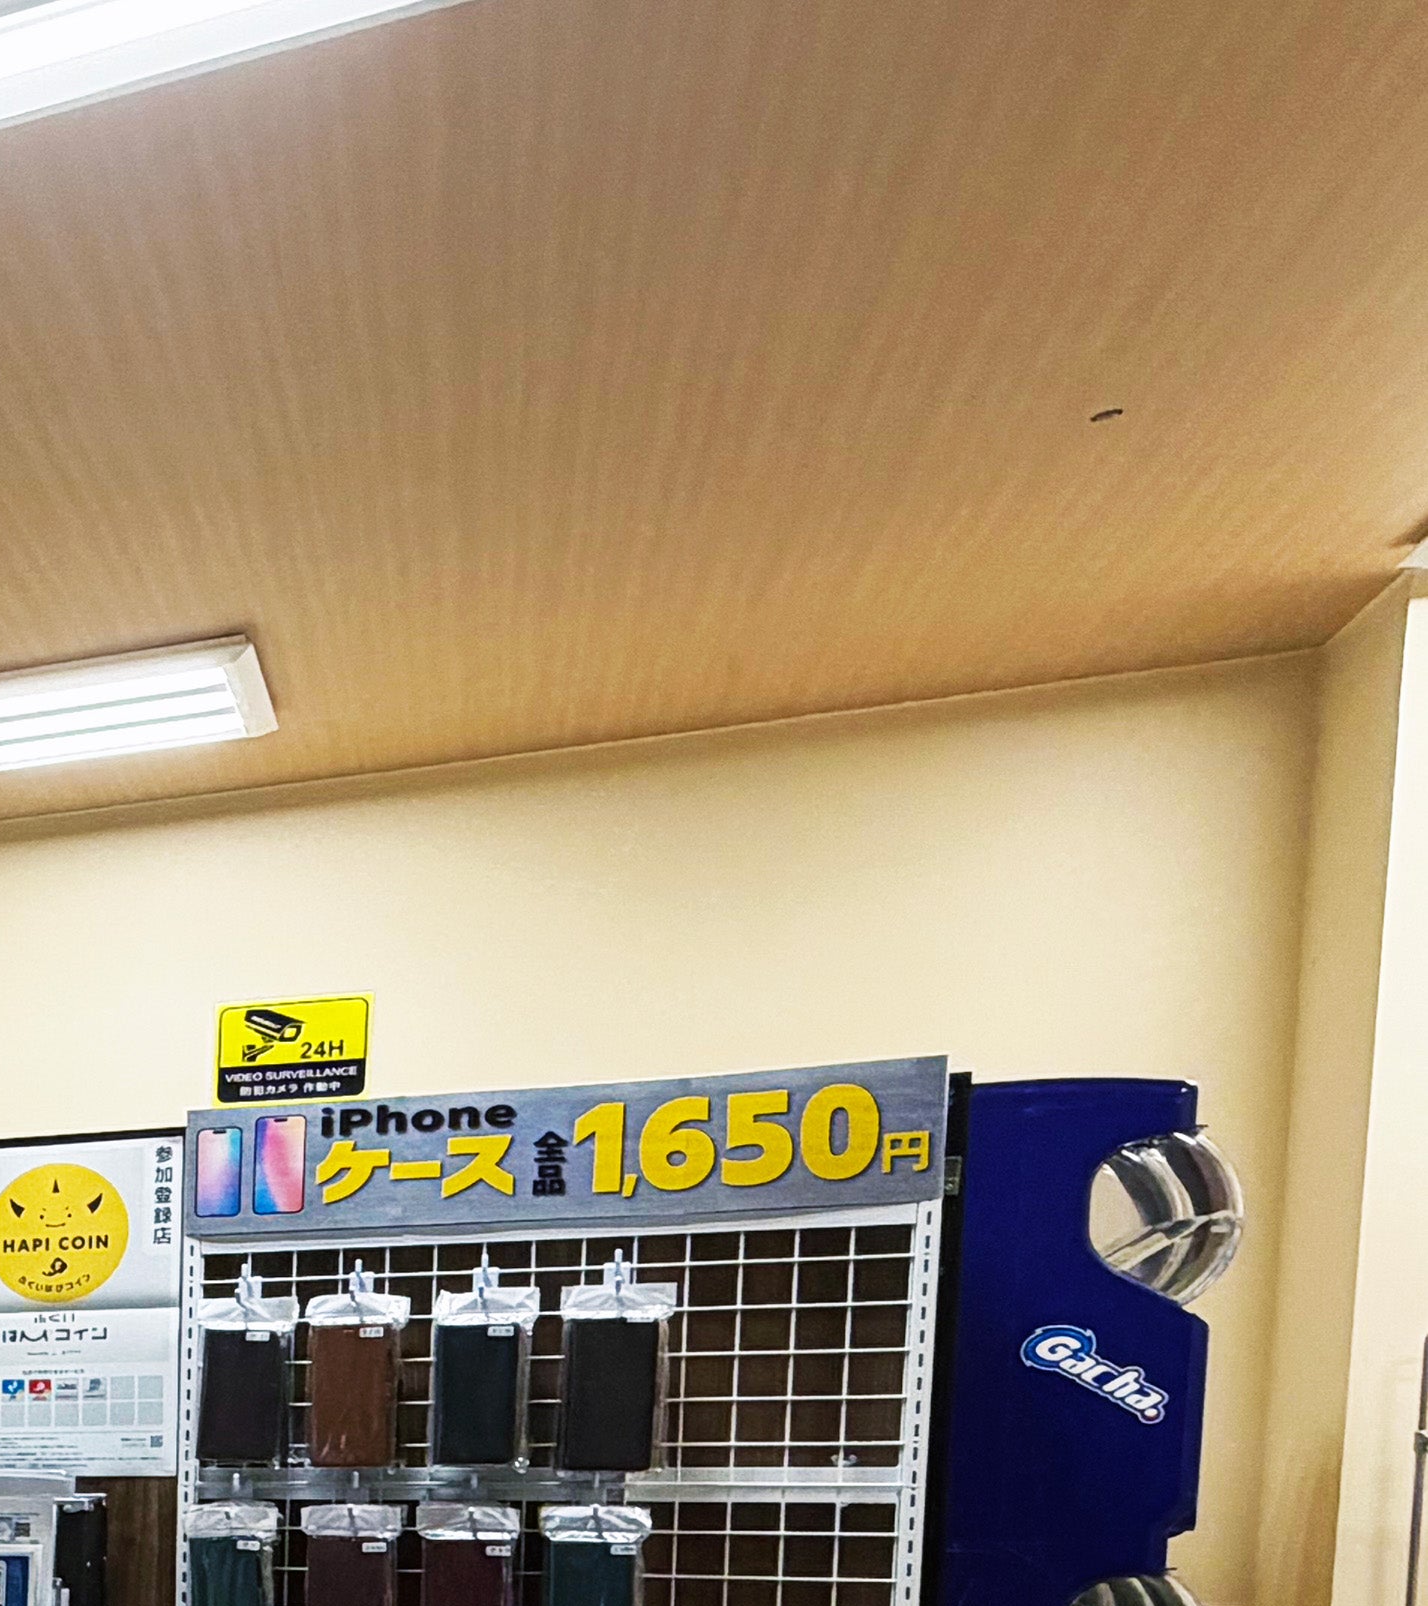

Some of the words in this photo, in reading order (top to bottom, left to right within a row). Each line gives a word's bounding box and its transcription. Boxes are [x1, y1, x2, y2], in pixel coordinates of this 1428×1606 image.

[299, 1039, 345, 1059] 24H
[225, 1071, 263, 1083] VIDEO
[265, 1065, 357, 1081] SURVEILLANCE
[320, 1102, 517, 1139] iPhone
[316, 1134, 515, 1205] ケース
[531, 1130, 568, 1197] 全品
[572, 1083, 930, 1198] 1,650円
[153, 1145, 173, 1246] 参加登録店
[3, 1236, 51, 1253] HAPI
[59, 1234, 110, 1250] COIN
